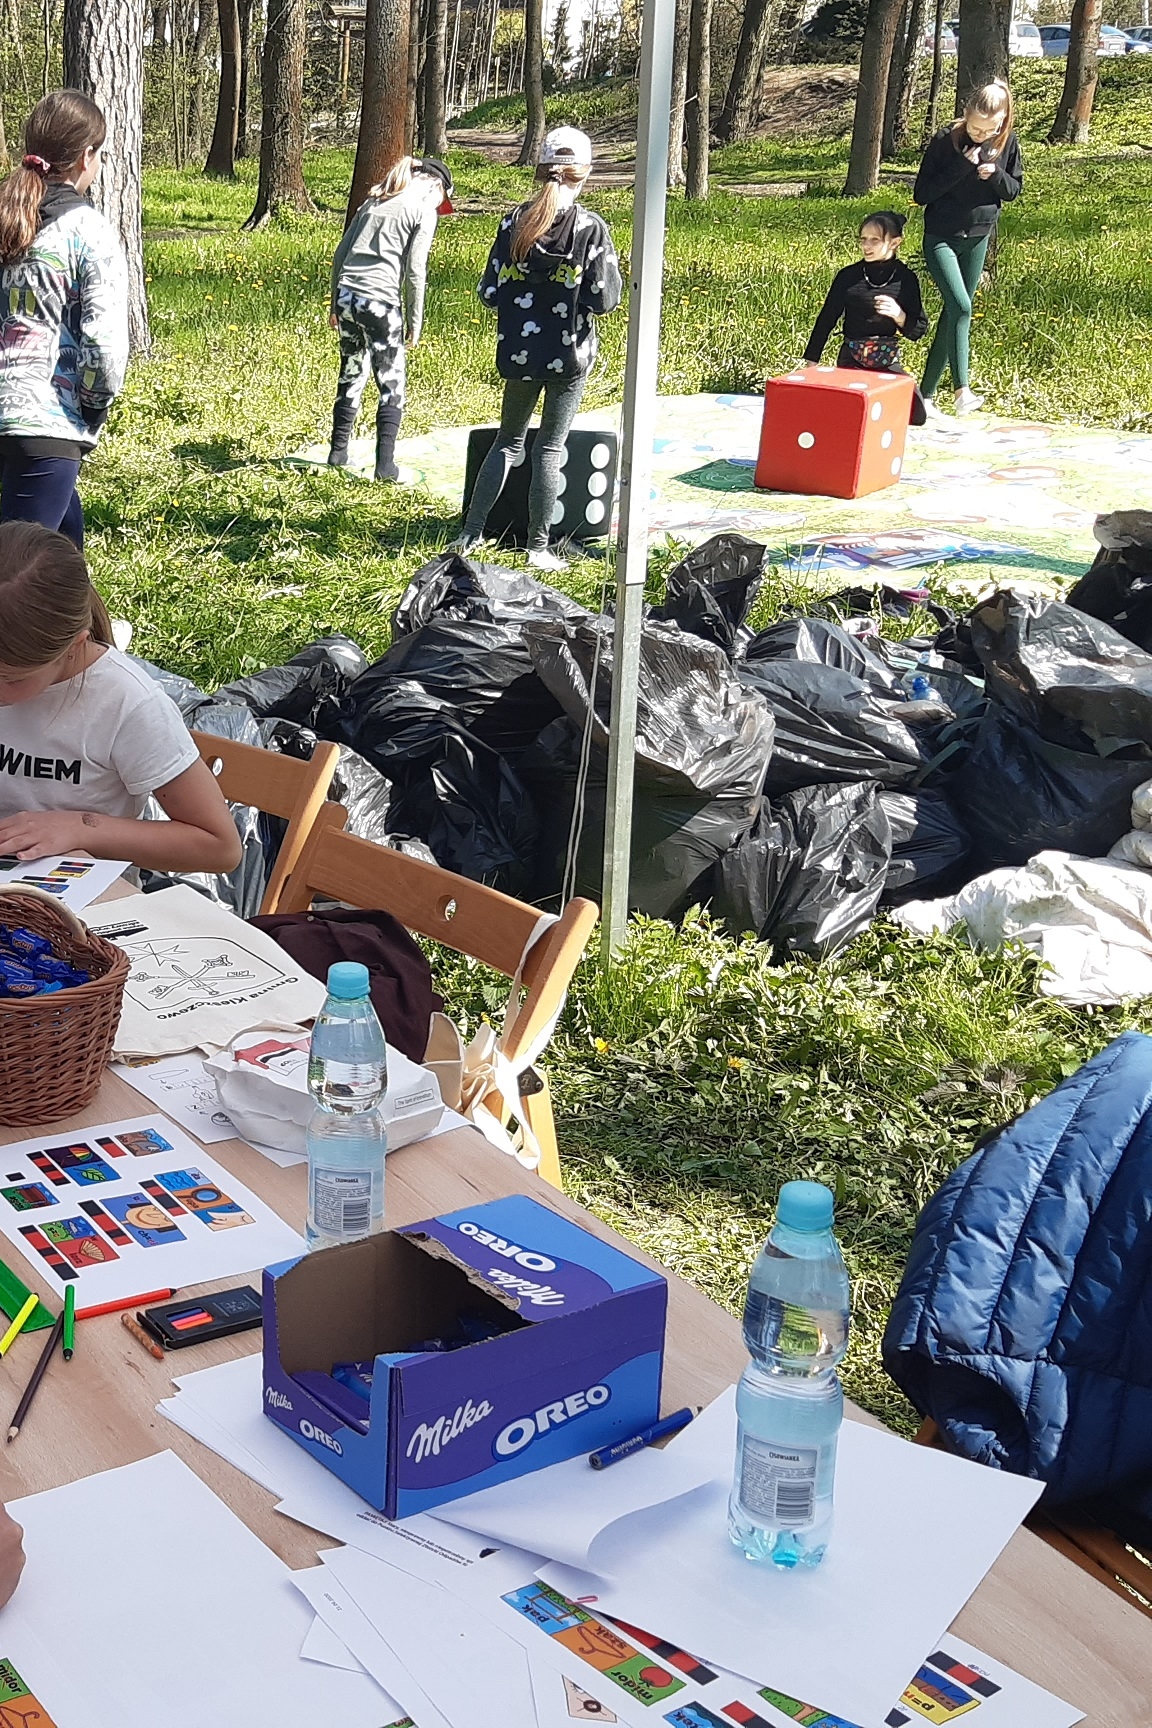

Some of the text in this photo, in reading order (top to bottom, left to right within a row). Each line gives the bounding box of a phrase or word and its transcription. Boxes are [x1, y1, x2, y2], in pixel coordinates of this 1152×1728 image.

[249, 977, 299, 999] Gmina
[458, 1222, 557, 1272] OREO
[487, 1266, 565, 1307] Milka
[266, 1385, 294, 1412] Milka
[299, 1419, 343, 1456] OREO
[406, 1399, 494, 1464] Milka
[495, 1385, 610, 1457] OREO
[610, 1670, 654, 1700] midor
